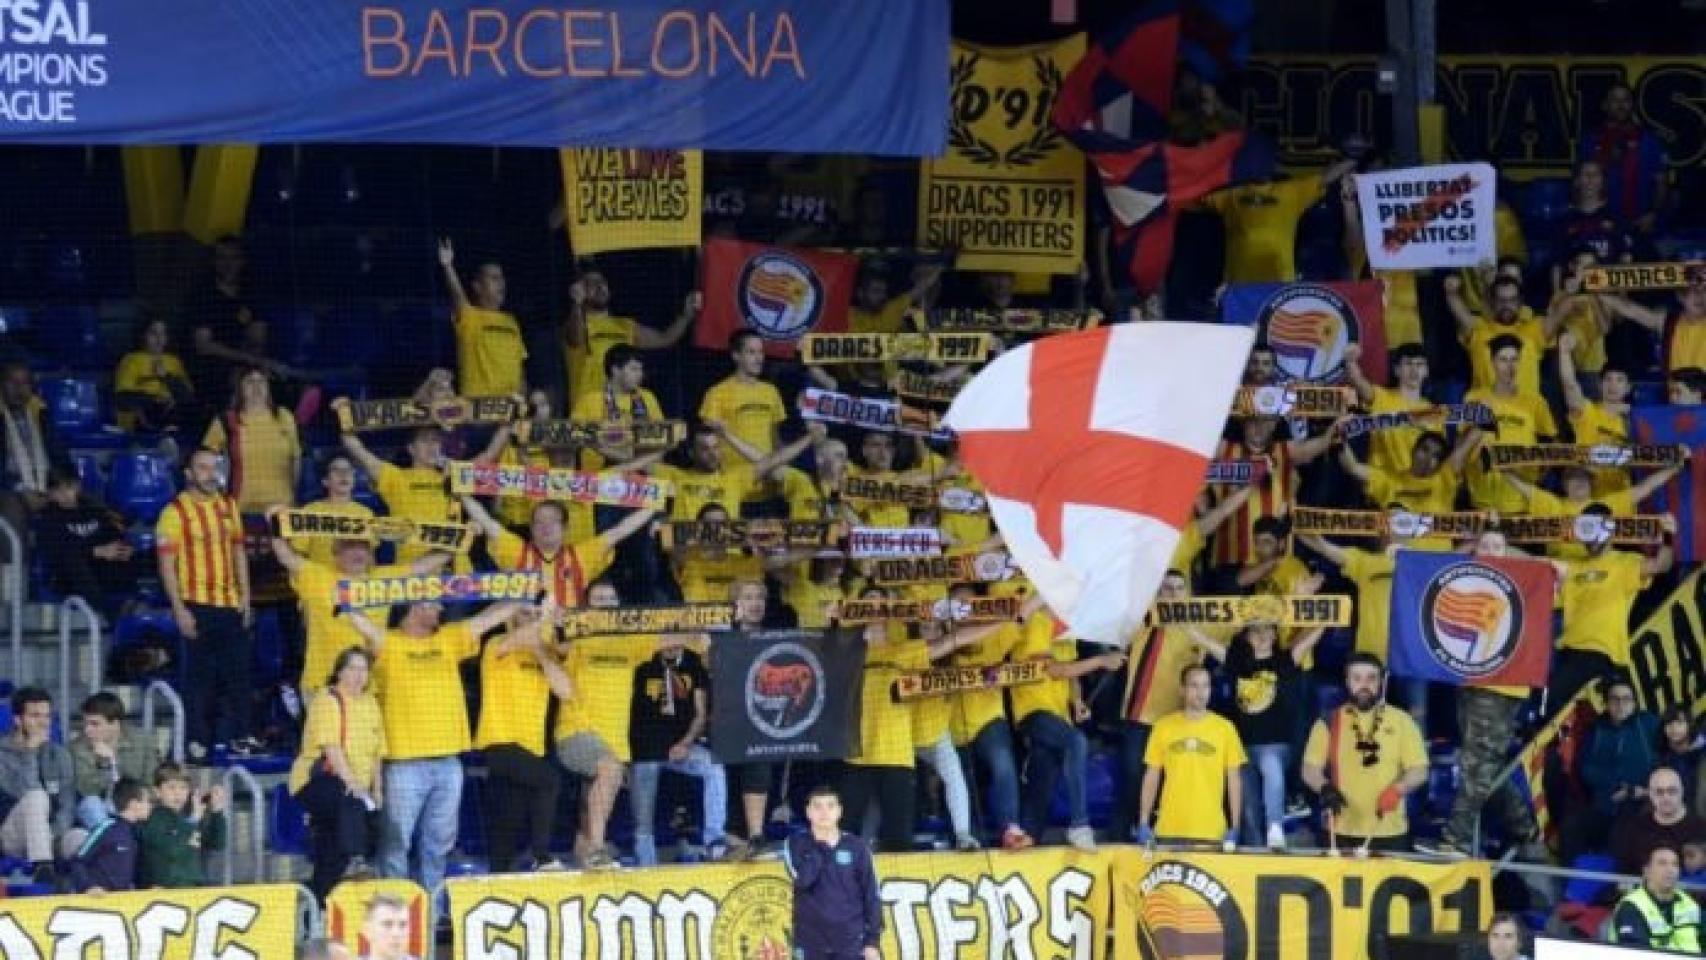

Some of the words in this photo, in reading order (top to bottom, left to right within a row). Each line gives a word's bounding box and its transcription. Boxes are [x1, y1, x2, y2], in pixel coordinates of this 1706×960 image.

[362, 8, 805, 78] BARCELONA
[928, 184, 1010, 216] DRACS
[1020, 187, 1075, 218] 1991
[928, 220, 1075, 250] SUPPORTERS
[350, 578, 441, 607] DRACS
[481, 572, 540, 600] 1991
[1158, 601, 1234, 623] DRACS
[1292, 599, 1340, 622] 1991
